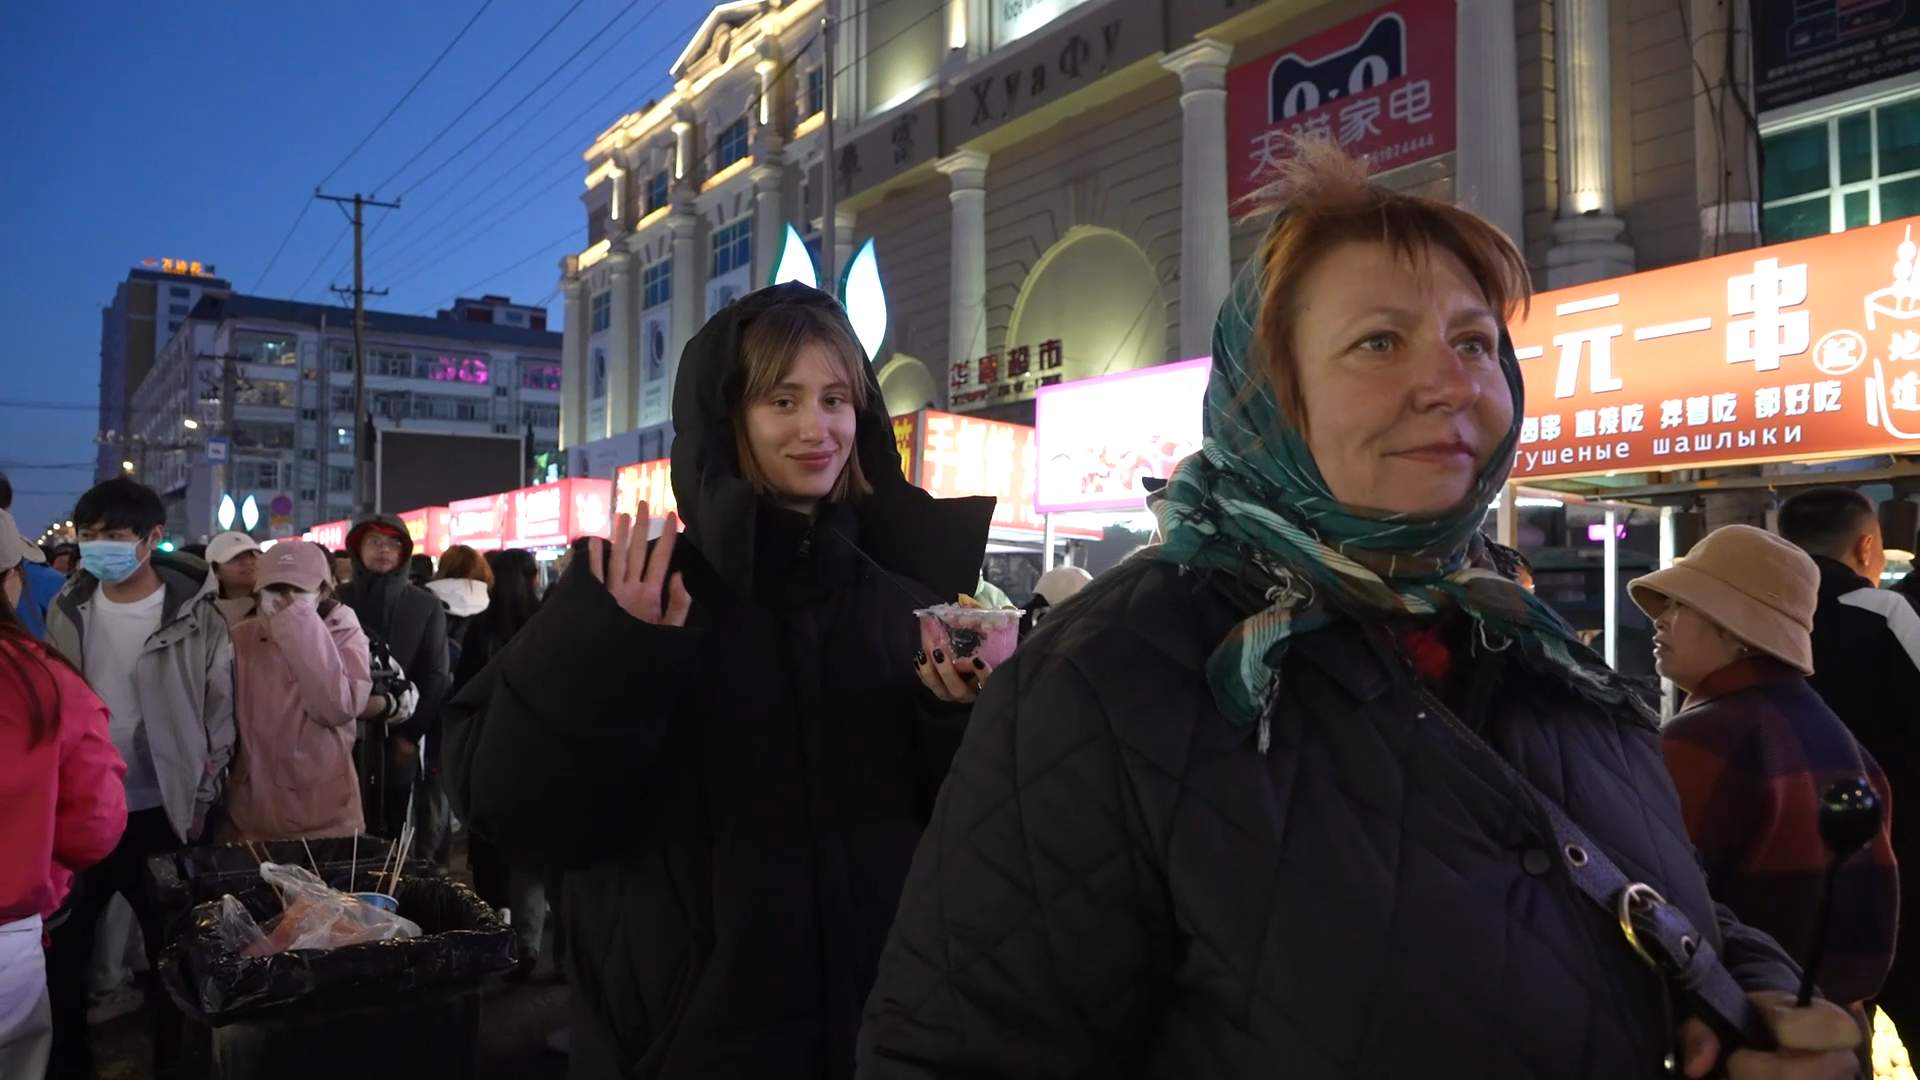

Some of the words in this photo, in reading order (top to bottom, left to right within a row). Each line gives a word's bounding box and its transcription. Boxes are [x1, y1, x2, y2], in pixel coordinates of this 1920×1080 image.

[1574, 403, 1645, 438] 直接吃
[1754, 380, 1842, 419] 都好吃
[1652, 425, 1802, 455] шашлыки
